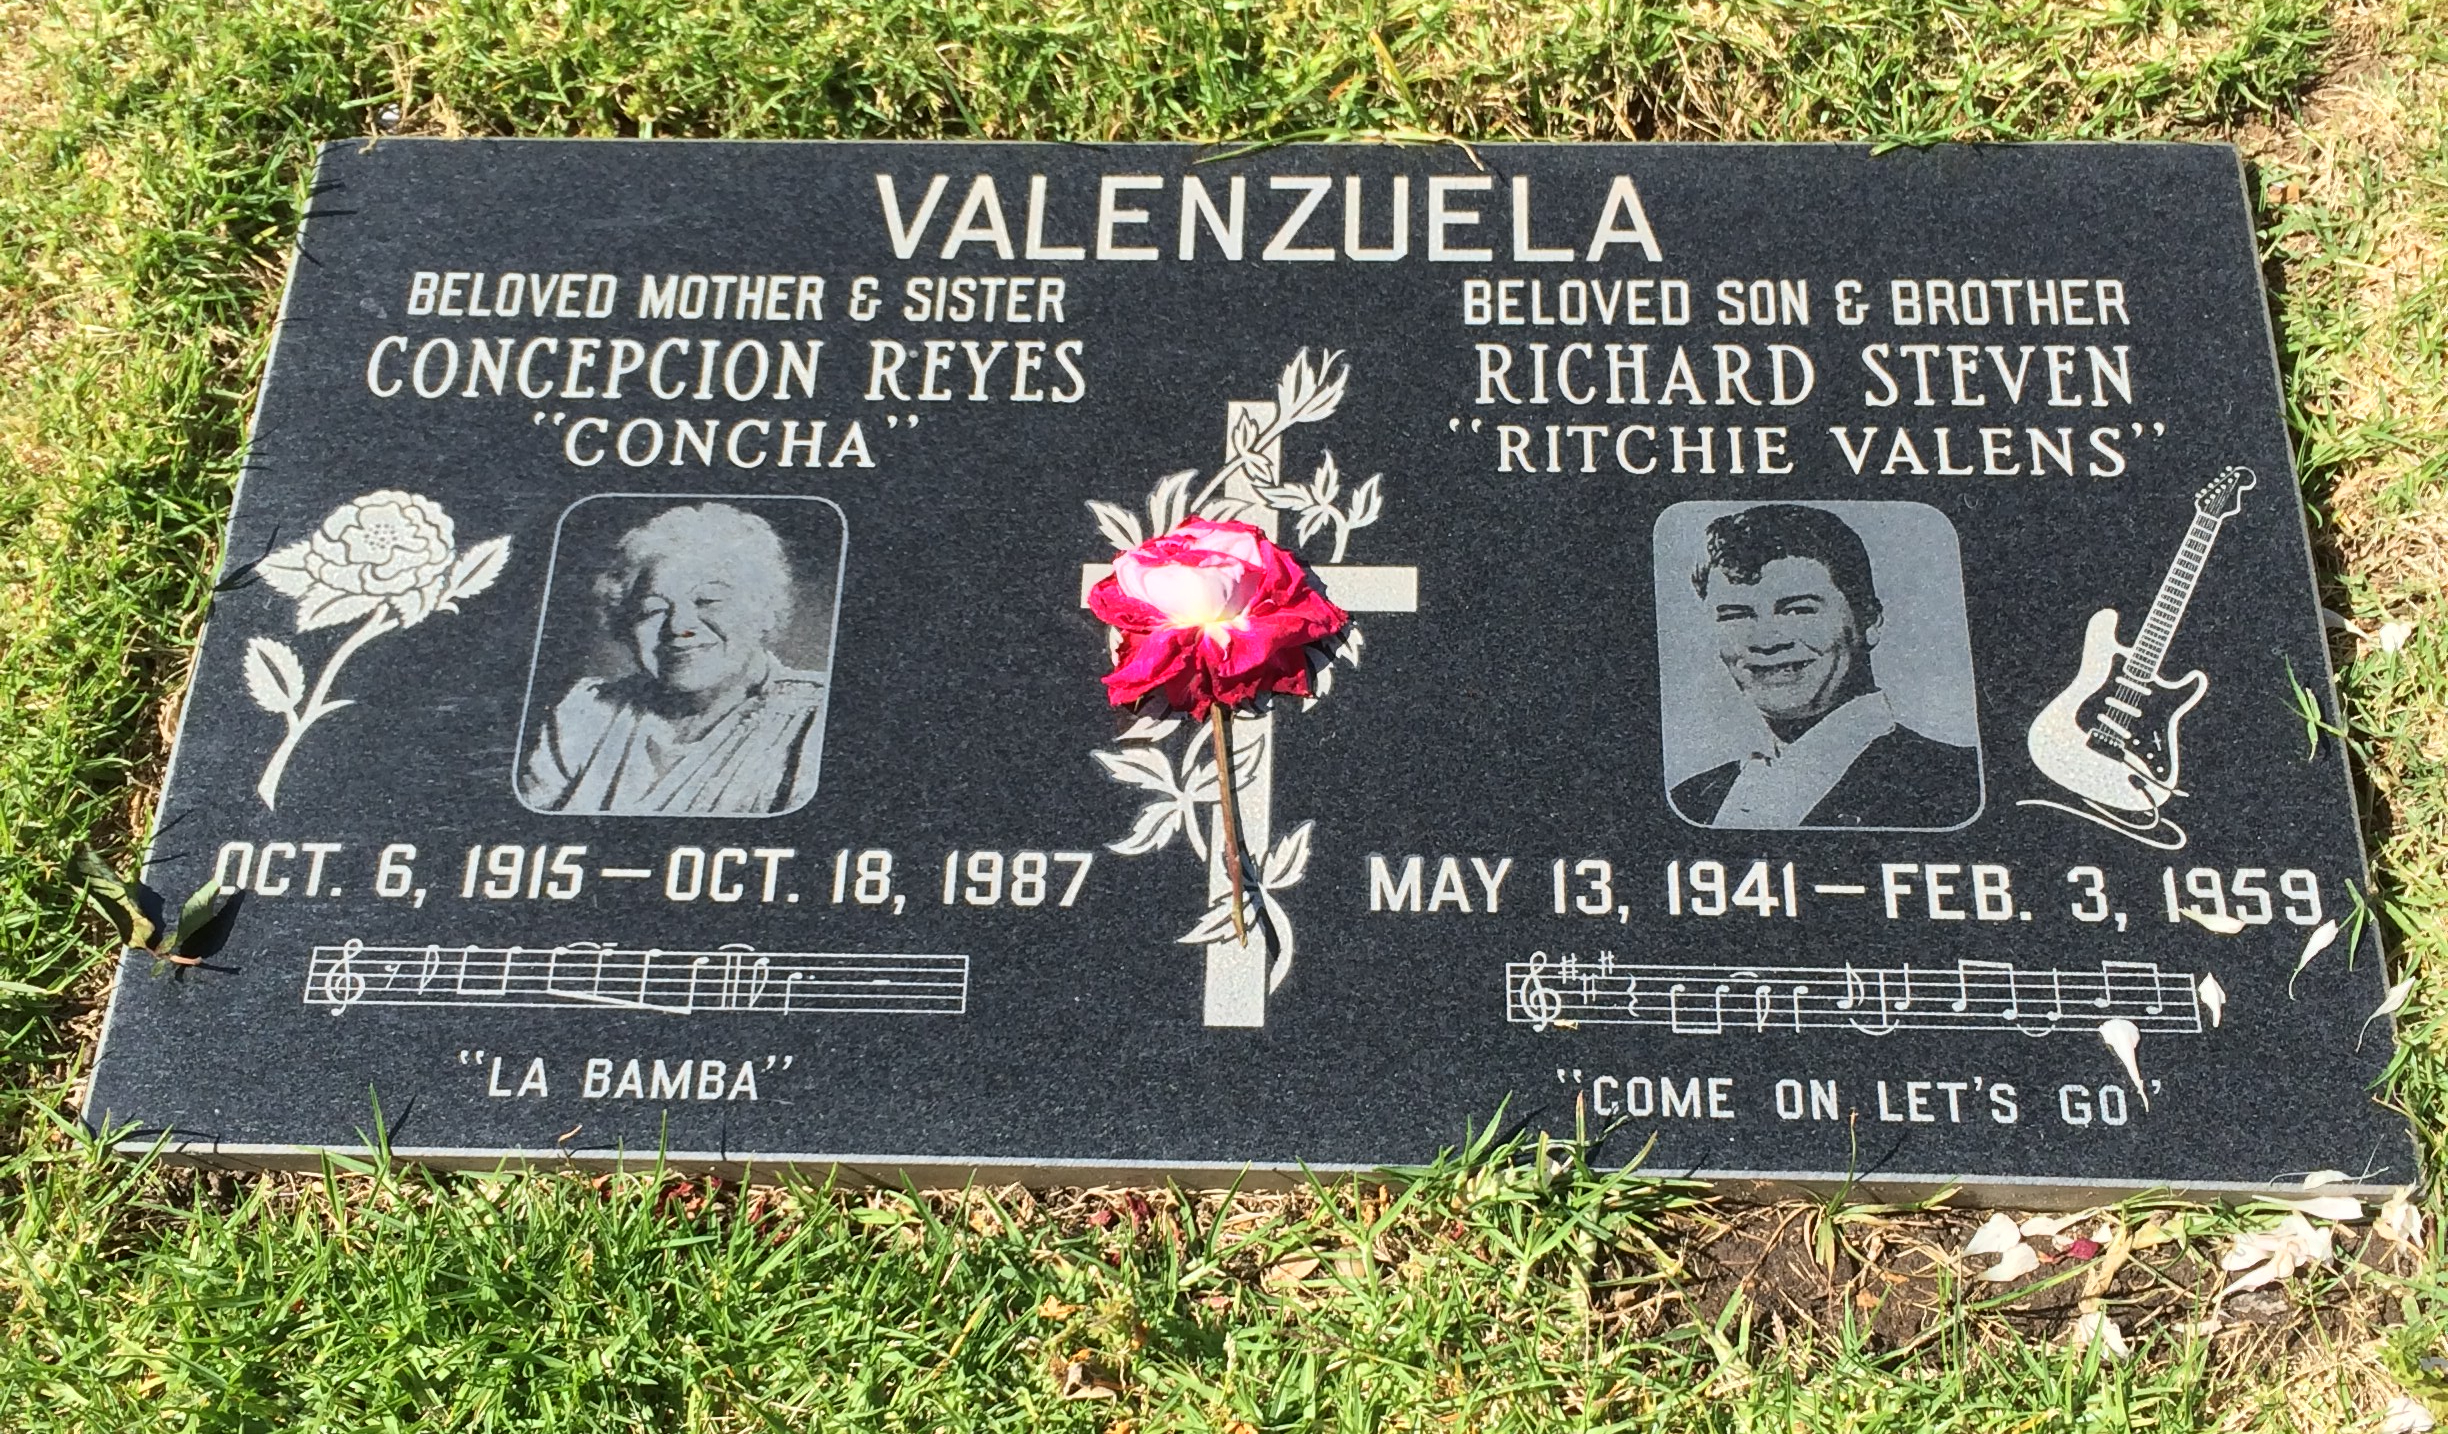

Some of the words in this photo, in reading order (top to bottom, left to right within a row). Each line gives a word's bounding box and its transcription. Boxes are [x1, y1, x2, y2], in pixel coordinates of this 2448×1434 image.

[876, 174, 1663, 262] VALENZUELA
[407, 271, 618, 318] BELOVED
[639, 274, 825, 320] MOTHER
[849, 276, 882, 321] &
[903, 277, 1066, 322] SISTER
[1464, 279, 1690, 325] BELOVED
[1717, 279, 1809, 325] SON
[1835, 280, 1870, 325] &
[1891, 279, 2130, 325] BROTHER
[367, 335, 825, 401] CONCEPCION
[864, 339, 1085, 403] REYES
[1475, 343, 1814, 406] RICHARD
[1862, 343, 2132, 407] STEVEN
[214, 840, 343, 897] OCT.
[374, 843, 426, 908] 6,
[832, 849, 905, 915] 18,
[943, 850, 1093, 907] 1987
[1366, 853, 1512, 913] MAY
[1553, 859, 1629, 924] 13,
[2067, 866, 2127, 932] 3,
[2163, 866, 2322, 926] 1959
[1775, 1079, 1838, 1120] ON
[1877, 1076, 2018, 1124] LET'S
